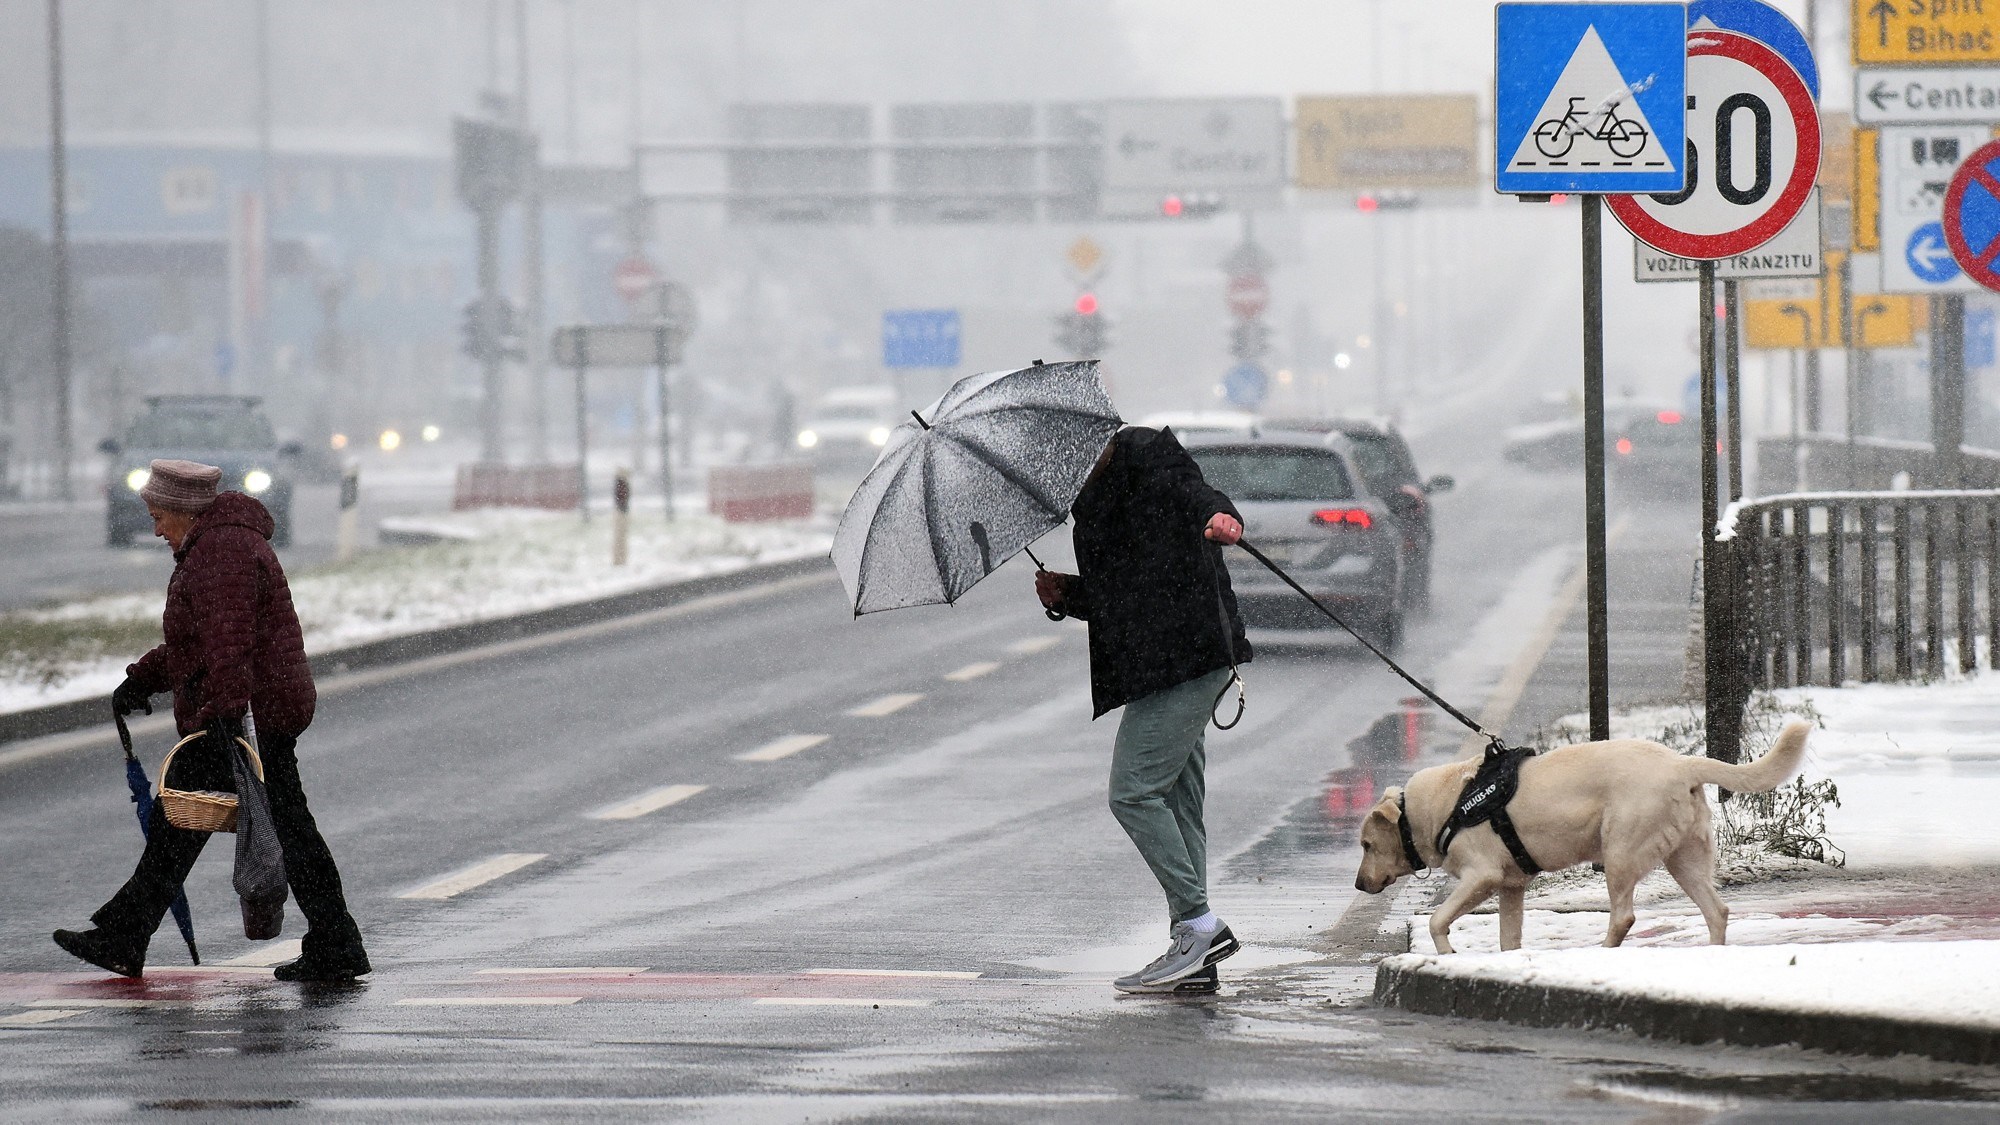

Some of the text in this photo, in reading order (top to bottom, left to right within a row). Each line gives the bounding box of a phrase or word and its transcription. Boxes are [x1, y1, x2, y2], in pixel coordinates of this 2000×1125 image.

[1904, 82, 2000, 109] Centa
[1731, 253, 1813, 271] TRANZITU
[1461, 784, 1496, 814] JULIUS-K9
